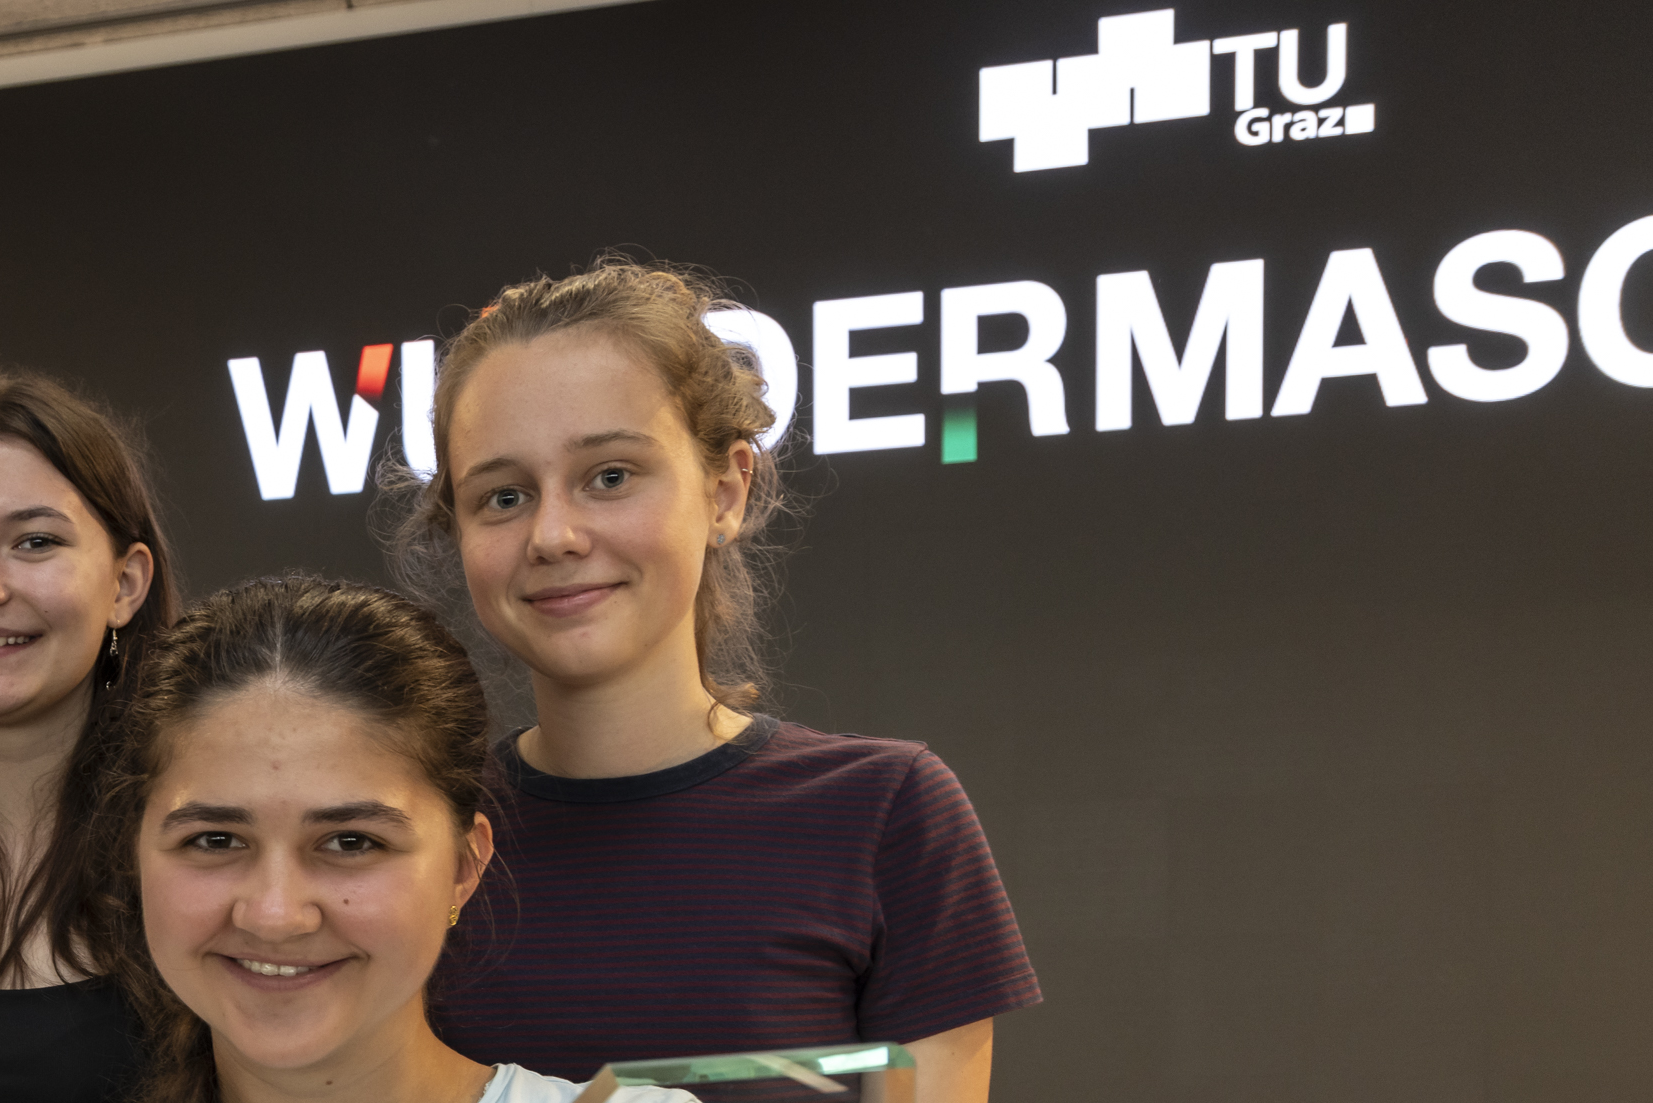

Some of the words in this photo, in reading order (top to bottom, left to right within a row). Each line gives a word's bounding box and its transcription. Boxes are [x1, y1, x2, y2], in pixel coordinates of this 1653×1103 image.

[1212, 21, 1349, 112] TU
[1234, 102, 1347, 146] Graz
[227, 213, 1653, 500] WDERMASC
